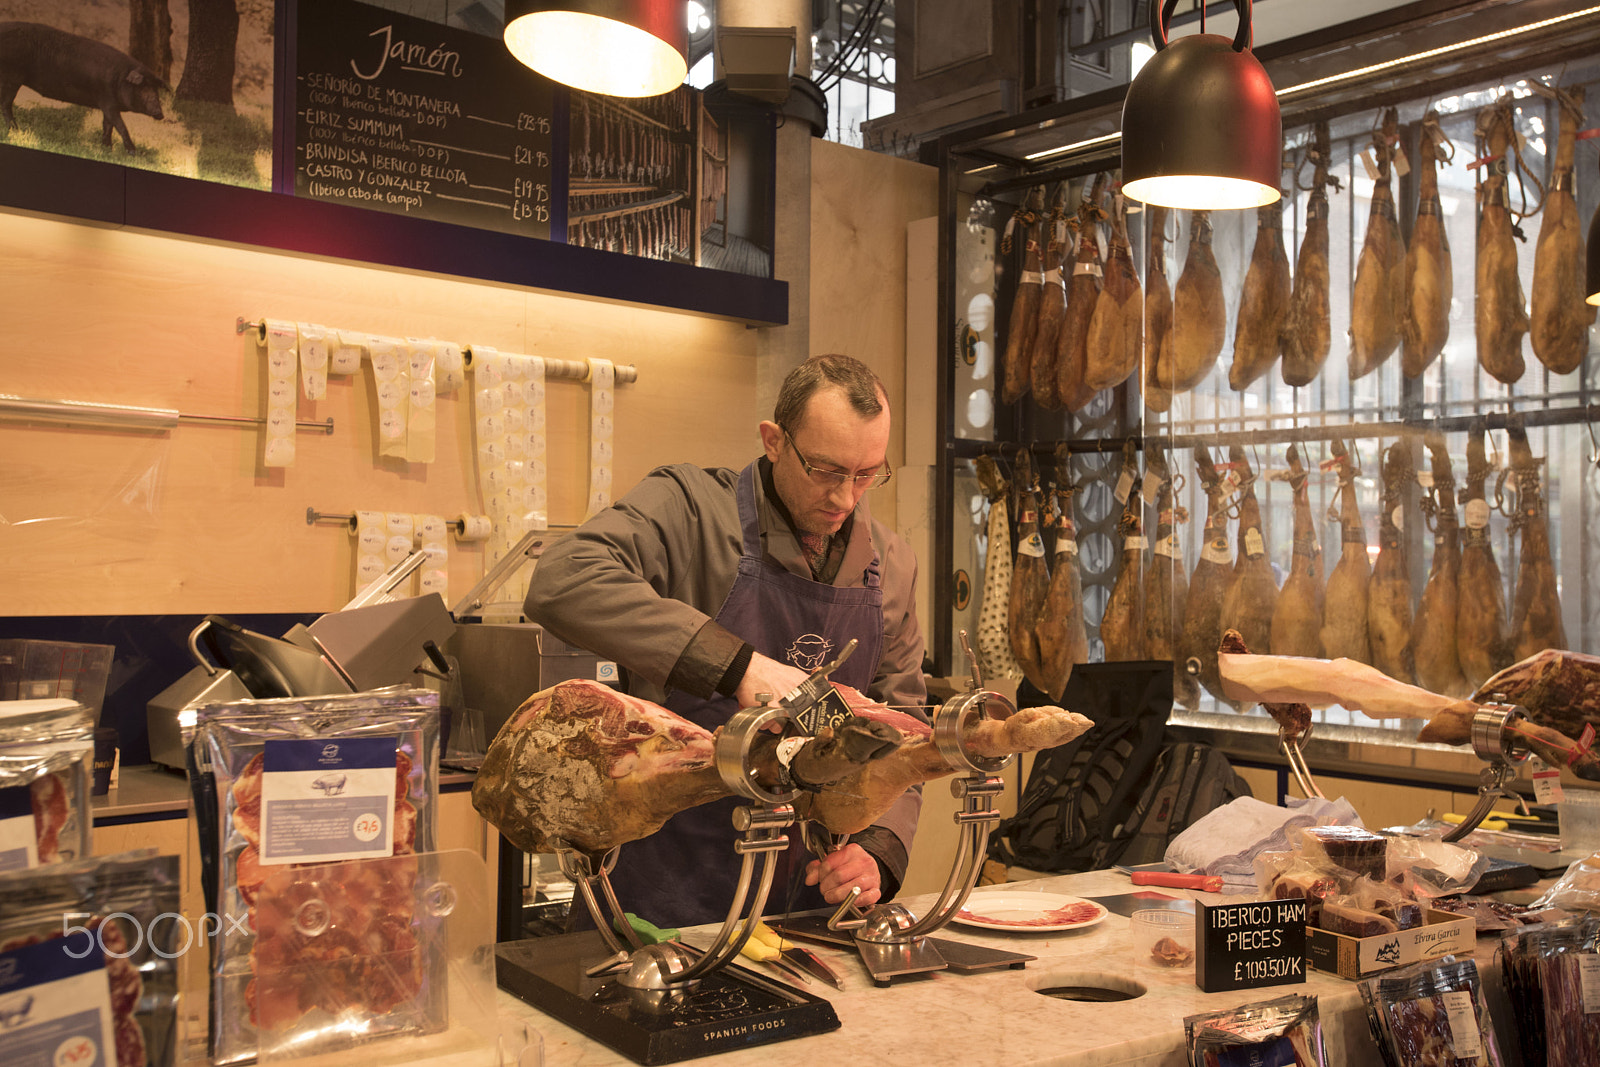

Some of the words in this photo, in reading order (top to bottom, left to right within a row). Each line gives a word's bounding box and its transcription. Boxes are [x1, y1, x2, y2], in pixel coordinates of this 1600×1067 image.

[351, 25, 463, 80] Jamón
[368, 84, 382, 100] DE
[386, 88, 461, 118] MONTANERA
[306, 108, 343, 128] EIRIZ
[347, 117, 403, 141] SUMMUM
[306, 143, 368, 164] BRINDISA
[372, 154, 417, 173] IBERICO
[420, 164, 468, 185] BELLOTA
[306, 162, 352, 181] CASTRO
[358, 169, 365, 183] Y
[367, 171, 431, 194] GONZALEZ
[372, 189, 383, 201] de
[1212, 906, 1272, 928] IBERICO
[1277, 903, 1306, 923] HAM
[1226, 929, 1284, 951] PIECES
[1414, 932, 1436, 944] Elvira
[704, 1025, 748, 1041] SPANISH
[751, 1018, 787, 1032] FOODS
